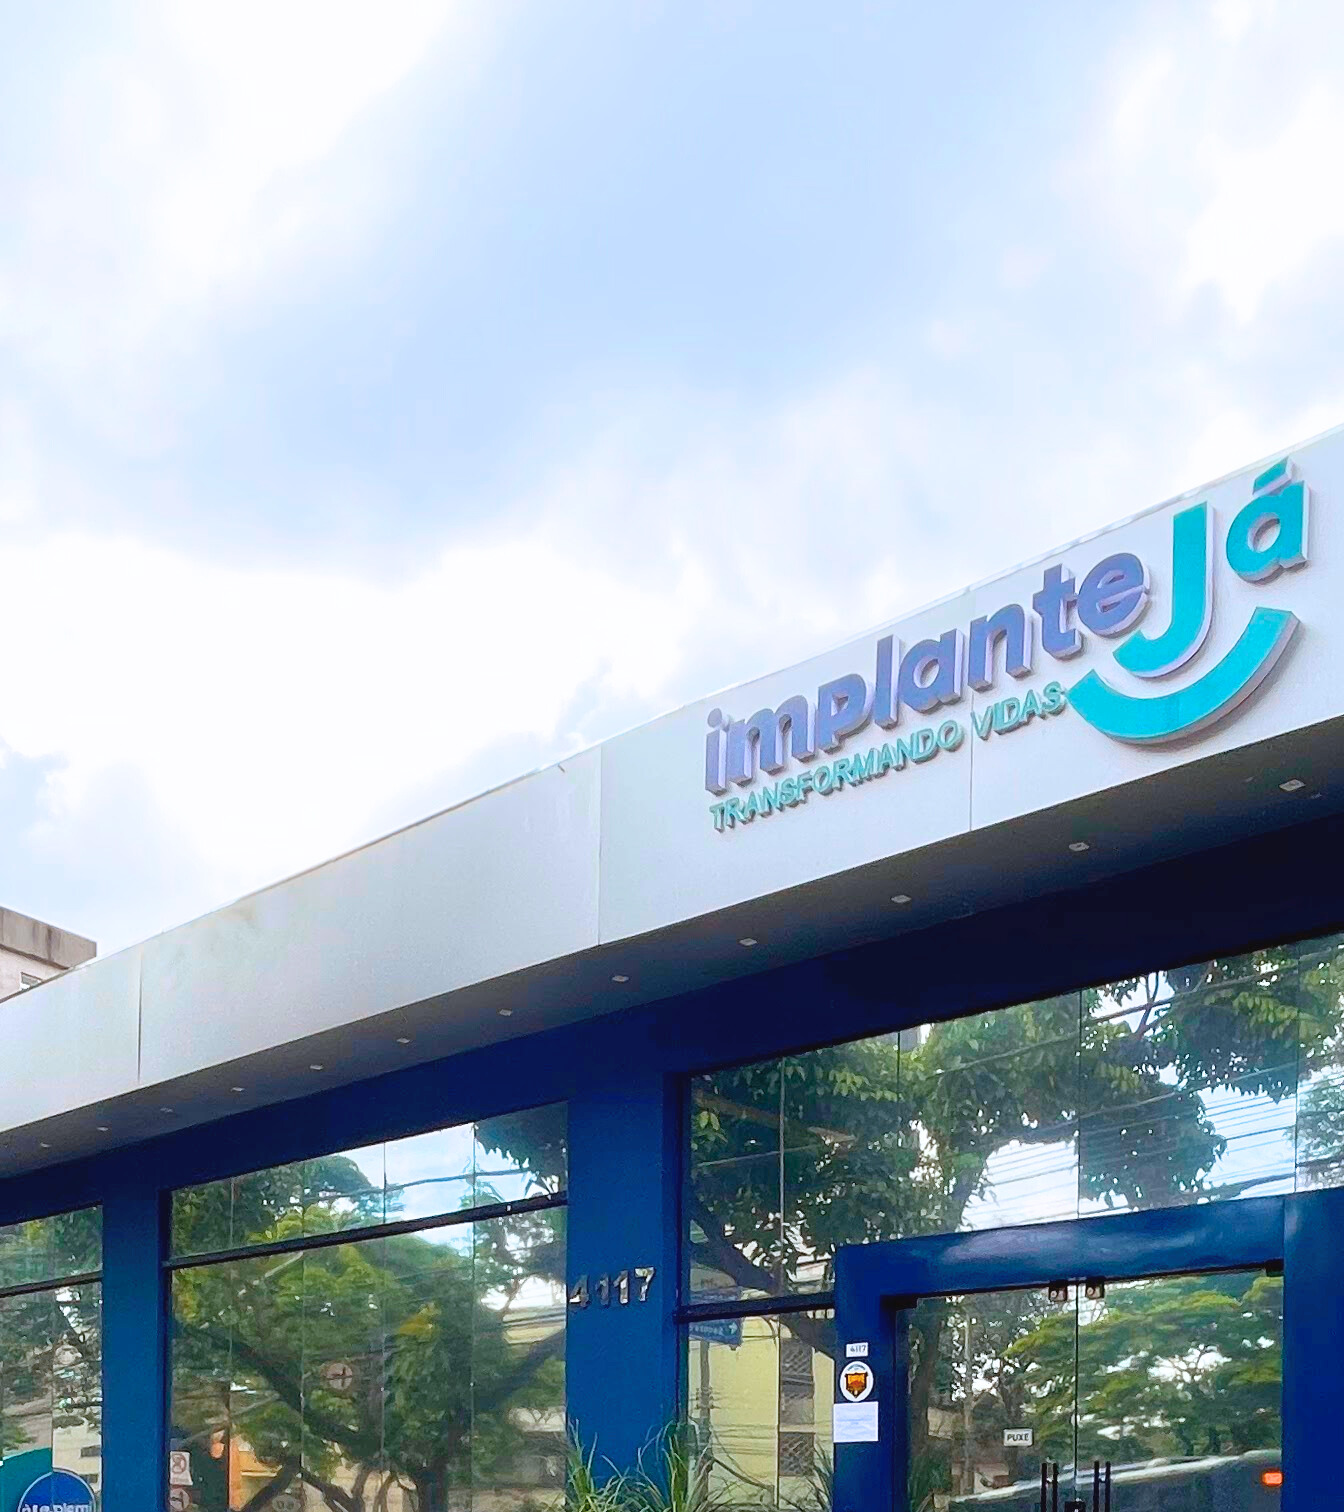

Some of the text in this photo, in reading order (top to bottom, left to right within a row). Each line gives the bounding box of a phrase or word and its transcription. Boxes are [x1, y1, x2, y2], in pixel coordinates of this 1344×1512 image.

[710, 681, 1067, 832] TRANSFORMANDO VIDAS
[568, 1266, 655, 1308] 4117
[1007, 1433, 1030, 1442] PUXE
